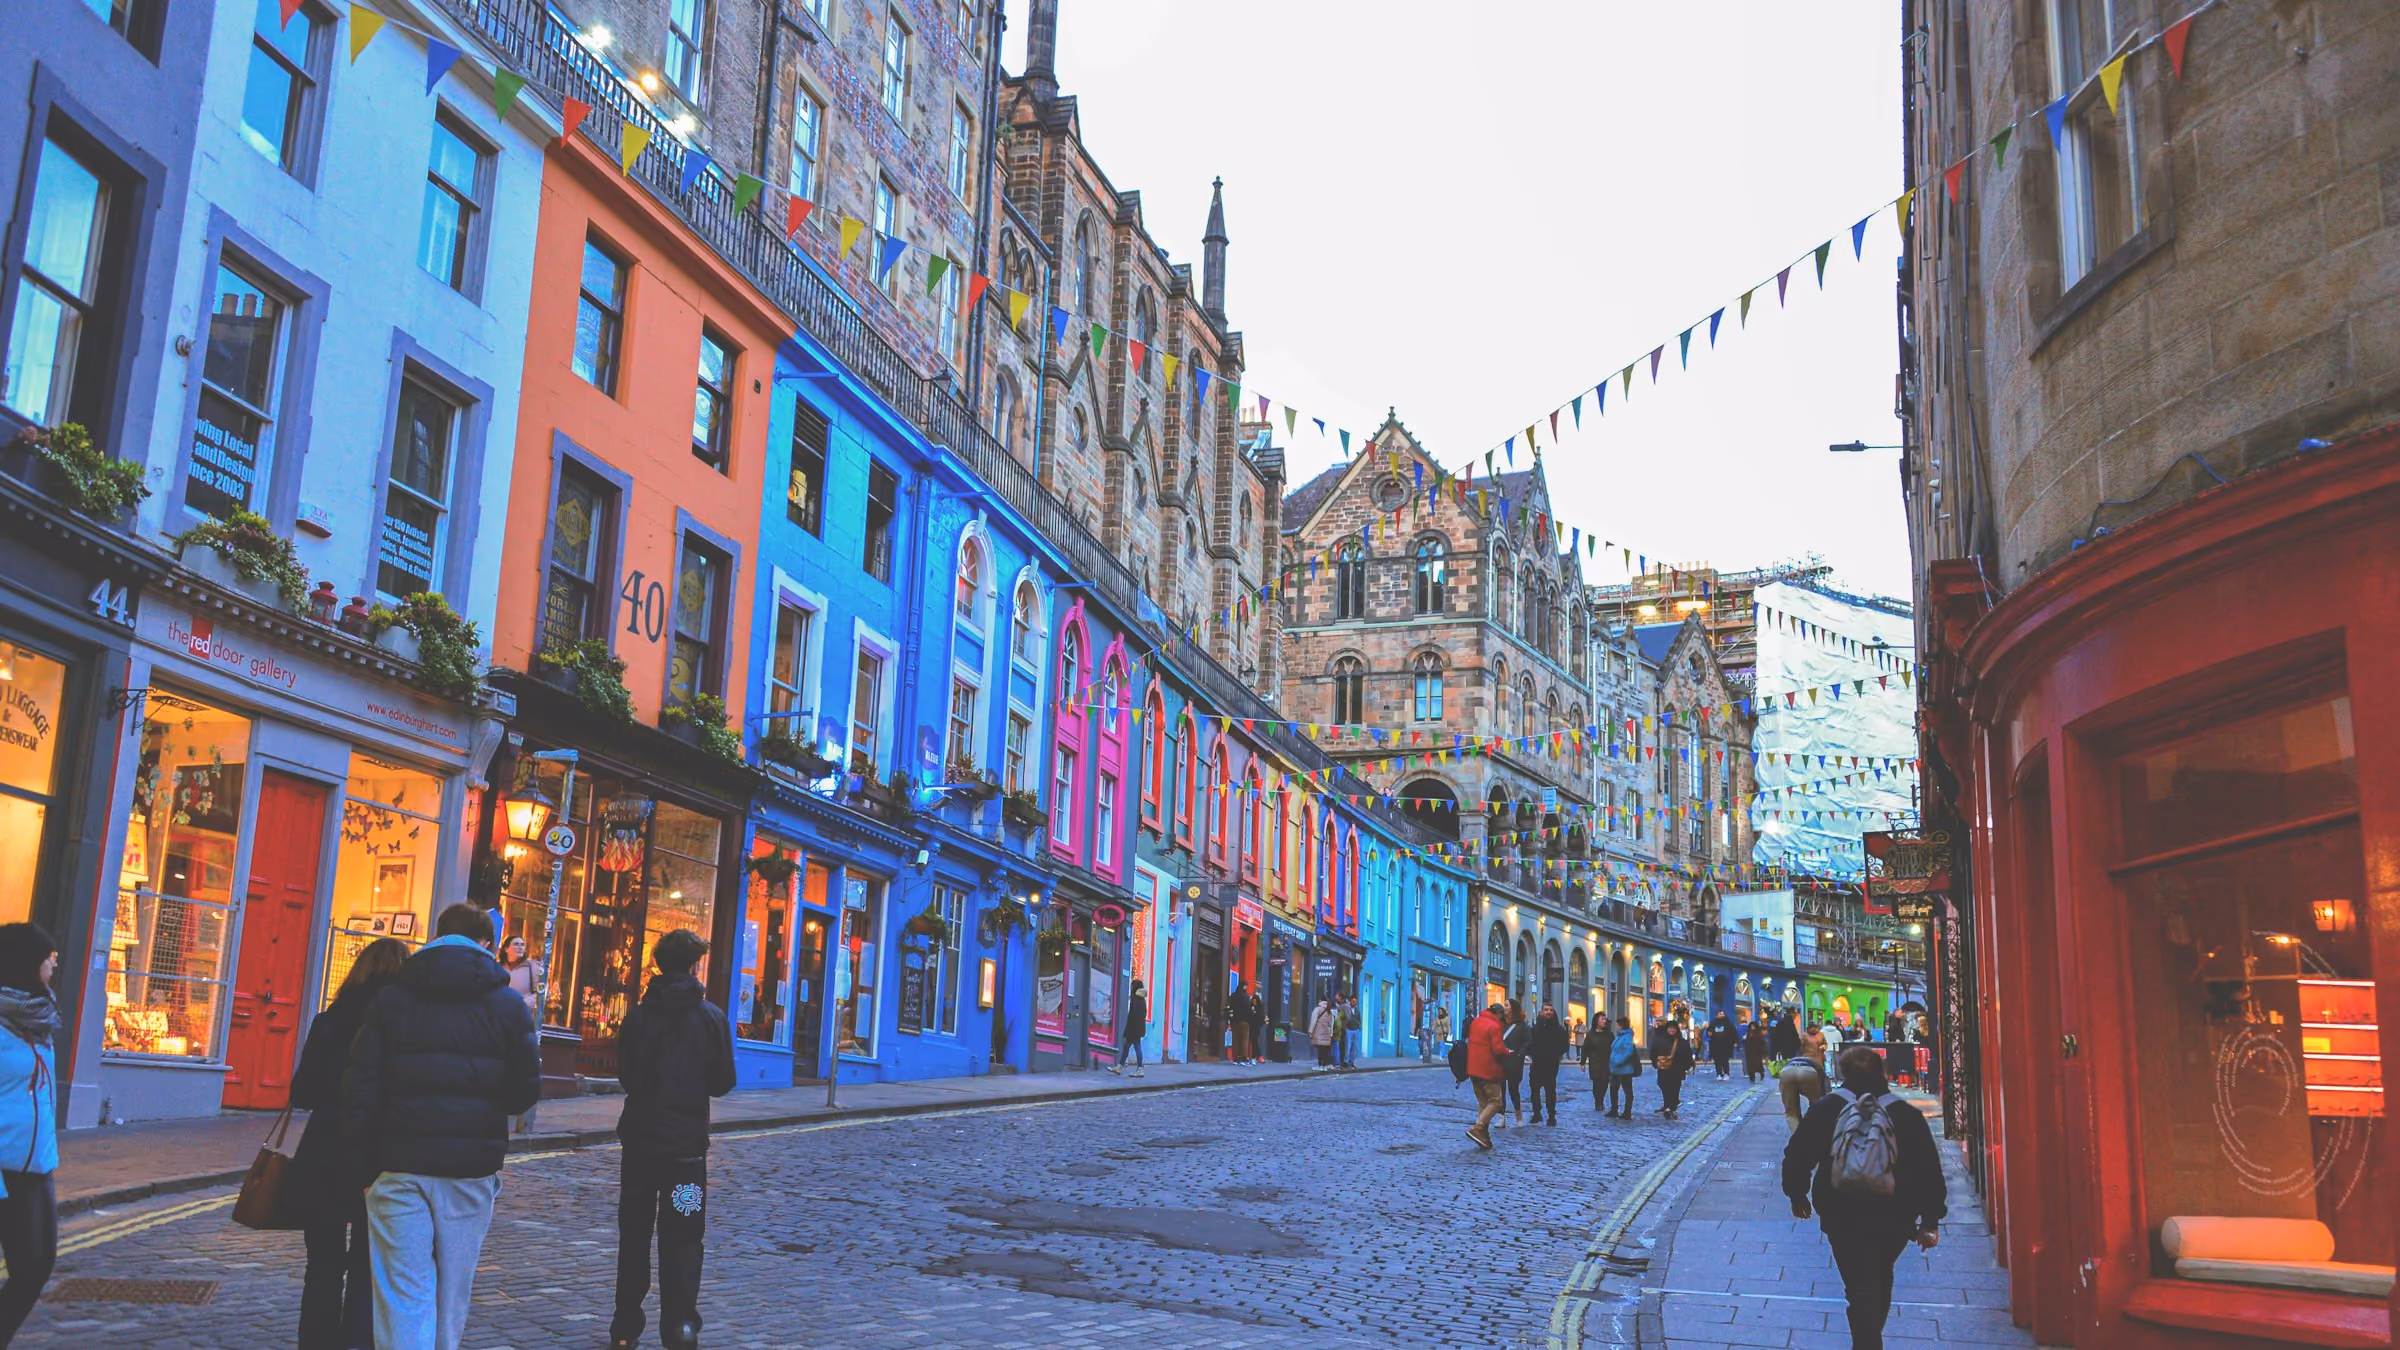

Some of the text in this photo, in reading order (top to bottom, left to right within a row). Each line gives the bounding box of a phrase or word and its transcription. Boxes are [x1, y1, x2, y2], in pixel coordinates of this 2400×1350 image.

[194, 441, 256, 483] and Design
[223, 430, 254, 461] Local
[188, 457, 245, 501] ince 2003
[88, 578, 136, 629] 44.
[621, 569, 665, 643] 40
[167, 621, 297, 688] the red door gallery
[2, 708, 12, 722] &
[6, 684, 51, 740] LUGGAGE
[366, 702, 457, 740] www.edinburghart.com
[548, 830, 574, 850] 20
